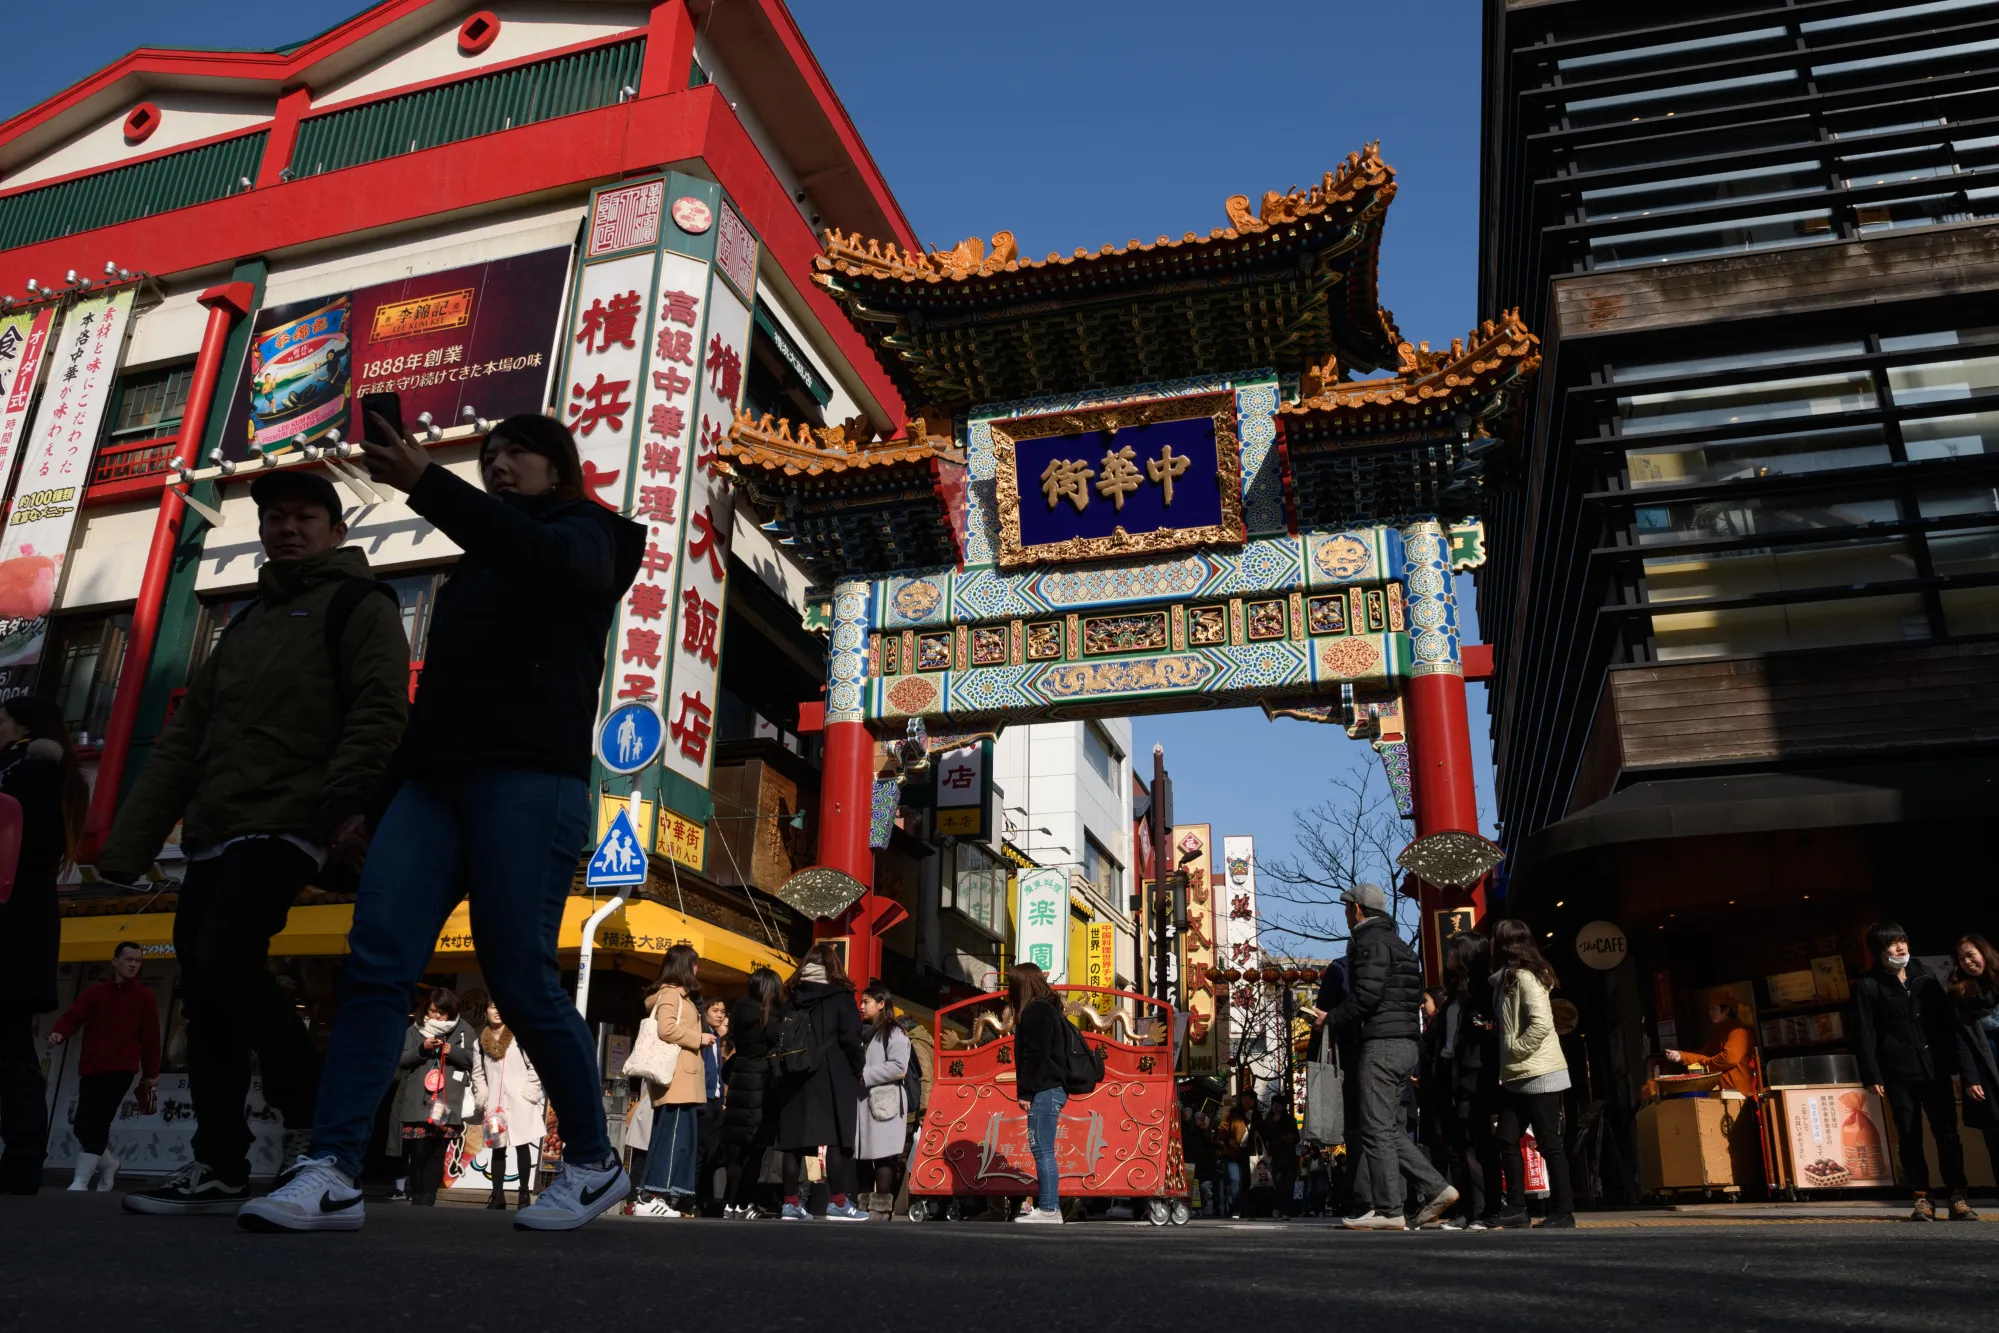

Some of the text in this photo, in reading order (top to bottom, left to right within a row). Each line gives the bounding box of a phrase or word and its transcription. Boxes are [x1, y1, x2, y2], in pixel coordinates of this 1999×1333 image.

[393, 323, 407, 333] LEE
[408, 320, 428, 331] KUM
[430, 317, 445, 328] KEE
[398, 300, 449, 324] 李錦記
[9, 329, 44, 409] オーダー式
[362, 344, 464, 379] 1888年創業
[356, 352, 543, 399] 伝統を守り続けてきた本場の味
[60, 306, 117, 474] 素材と味にこだわった
[262, 408, 336, 444] PREMIUM OYSTER SAUCE
[277, 410, 320, 433] LEE KUM KEE
[1040, 443, 1192, 512] 中華街
[18, 487, 76, 509] 約100種類
[10, 506, 74, 526] 豊富なメニュー
[941, 764, 976, 789] 店
[659, 812, 700, 850] 中華街
[944, 815, 973, 827] 本店
[657, 838, 698, 865] 大通り入口
[439, 934, 477, 949] 大粒甘
[1028, 899, 1057, 971] 楽園
[1579, 936, 1625, 953] The CAFE
